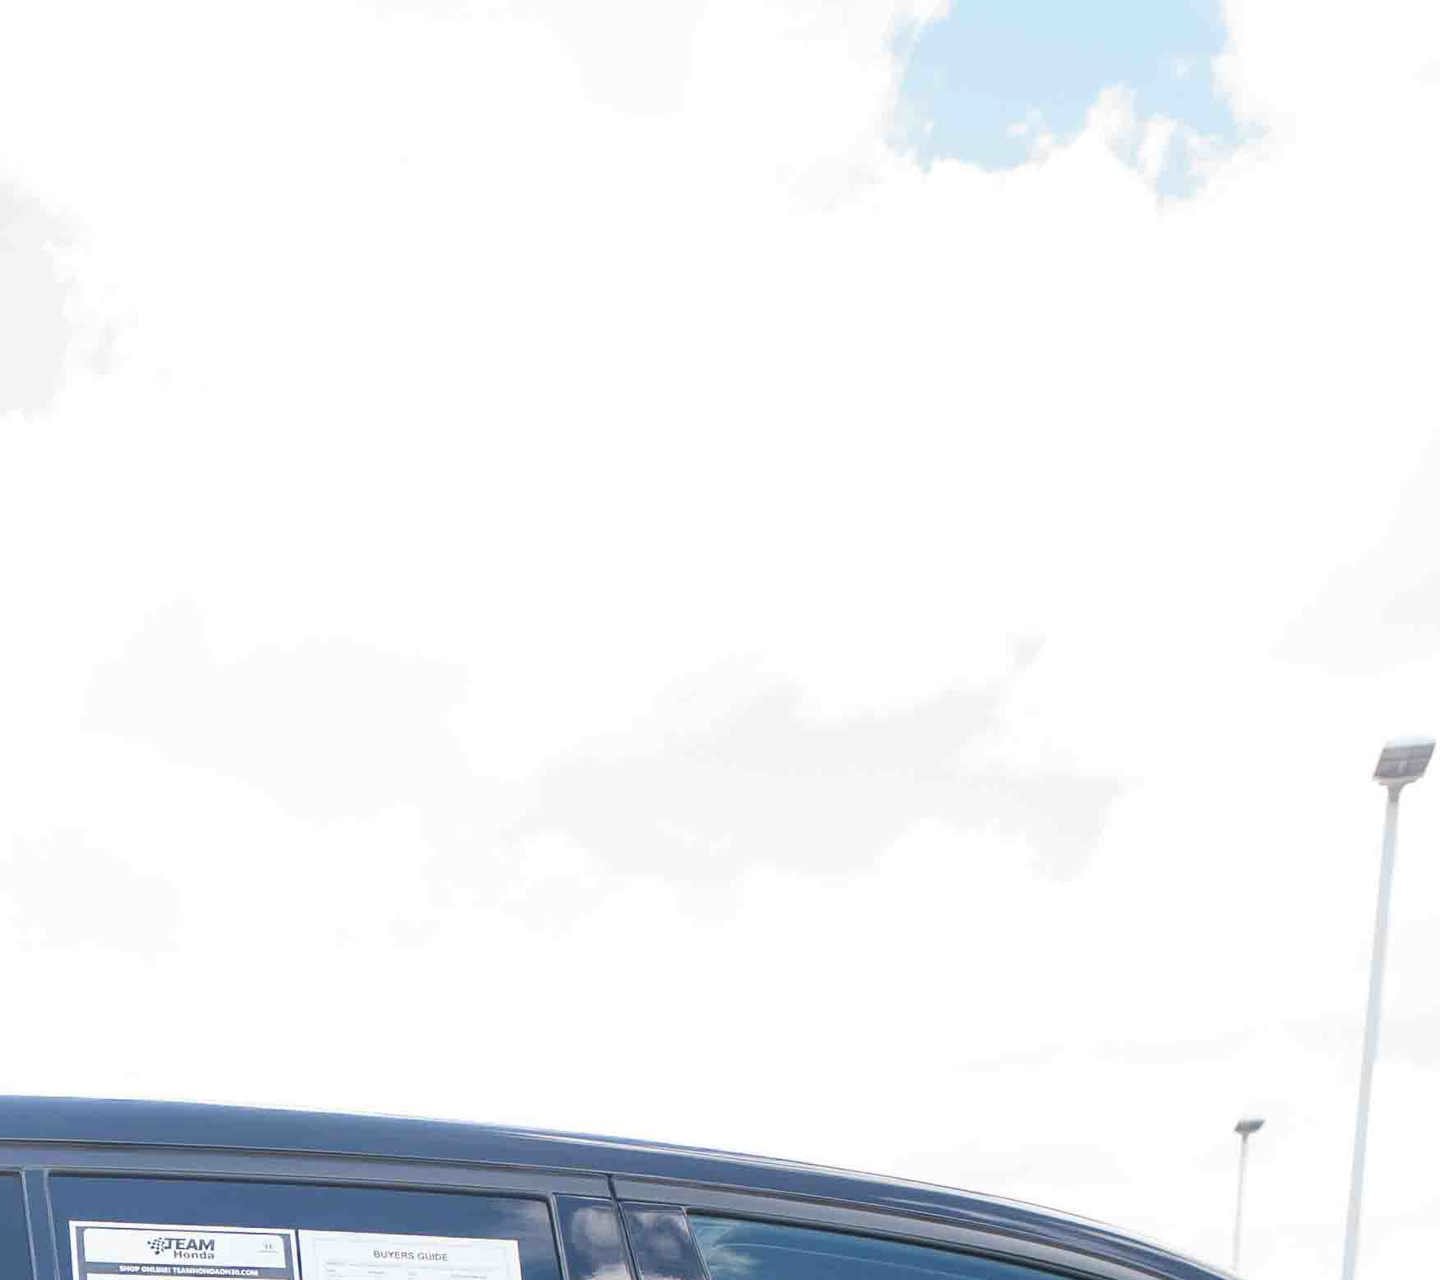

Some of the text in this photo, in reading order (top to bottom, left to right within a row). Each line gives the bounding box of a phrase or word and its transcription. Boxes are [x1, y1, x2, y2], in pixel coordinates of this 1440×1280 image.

[165, 1237, 215, 1251] TEAM
[173, 1250, 215, 1260] Honda
[373, 1249, 448, 1262] BUYERS GUIDE
